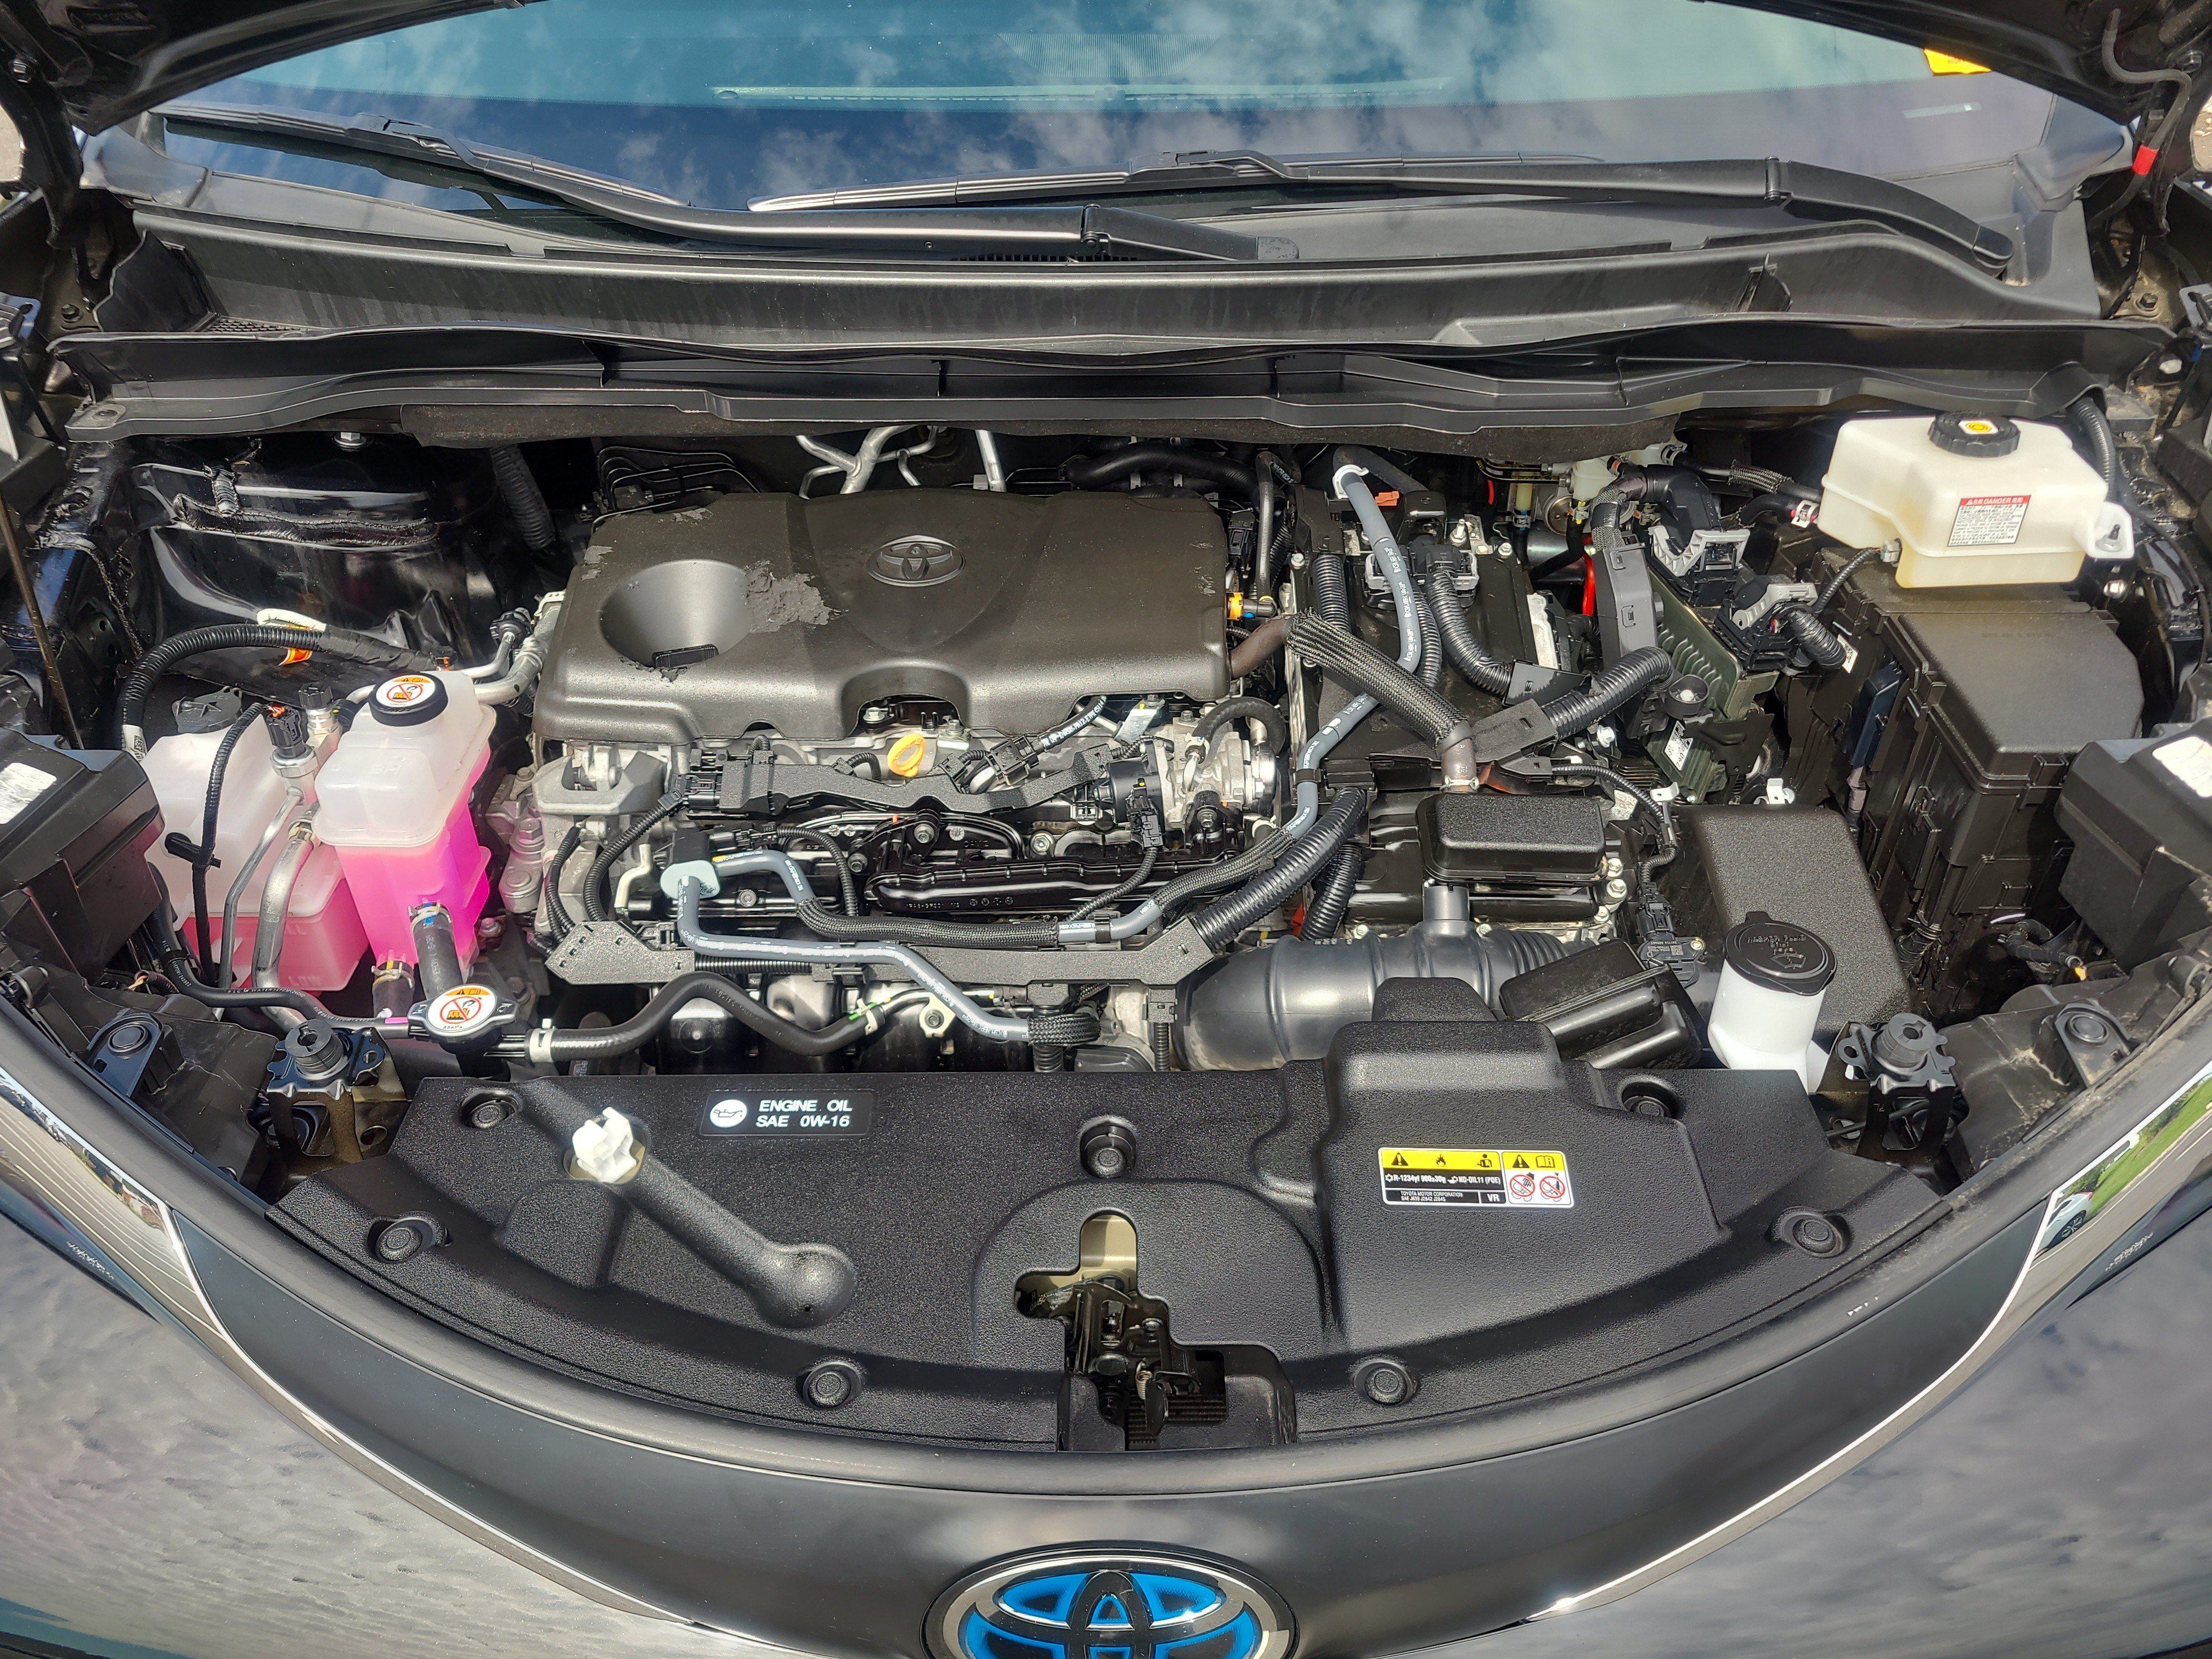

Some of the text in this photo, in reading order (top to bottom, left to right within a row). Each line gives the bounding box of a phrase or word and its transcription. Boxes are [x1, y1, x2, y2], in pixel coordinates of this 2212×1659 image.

[759, 1099, 853, 1111] ENGINE OIL
[755, 1115, 850, 1127] SAE 0W-16
[1393, 1174, 1420, 1184] R-1234yf
[1458, 1176, 1484, 1184] ND-OIL11
[1485, 1176, 1501, 1185] (POE)
[1486, 1193, 1499, 1202] VR
